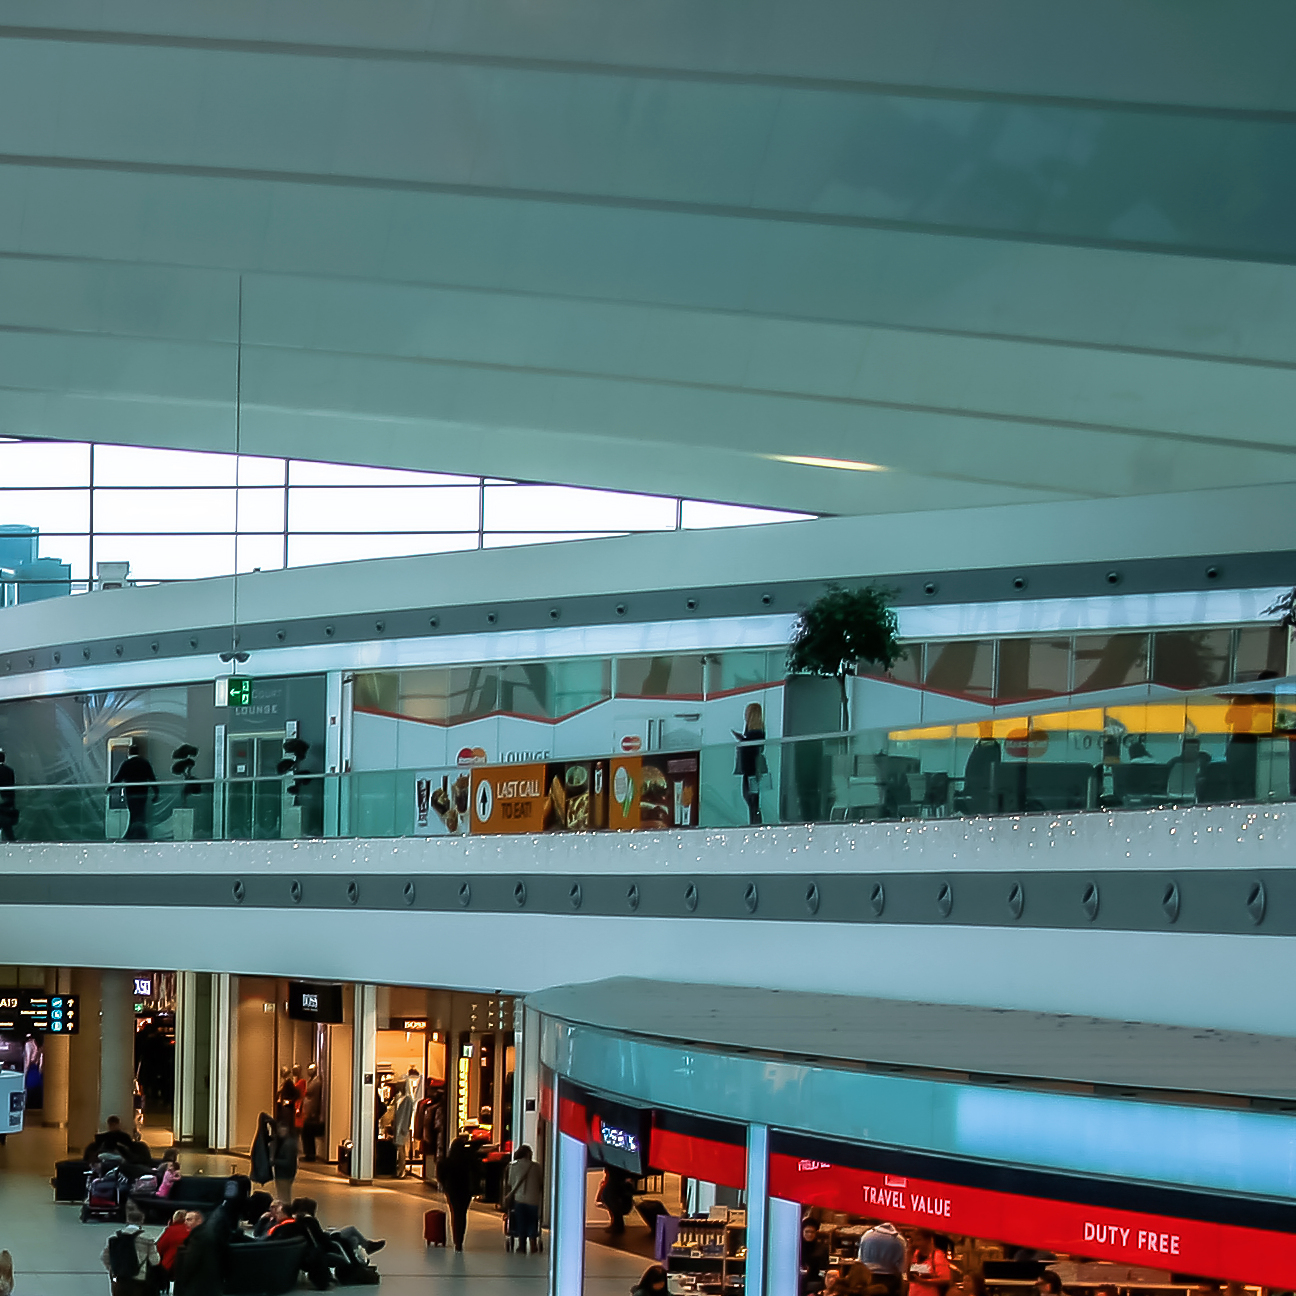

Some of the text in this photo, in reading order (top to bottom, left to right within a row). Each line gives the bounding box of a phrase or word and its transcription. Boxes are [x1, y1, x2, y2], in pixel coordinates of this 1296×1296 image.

[235, 704, 278, 716] LOUNGE
[496, 779, 541, 799] LAST CALL
[862, 1186, 951, 1217] TRAVEL VALUE
[1084, 1222, 1180, 1255] DUTY FREE
